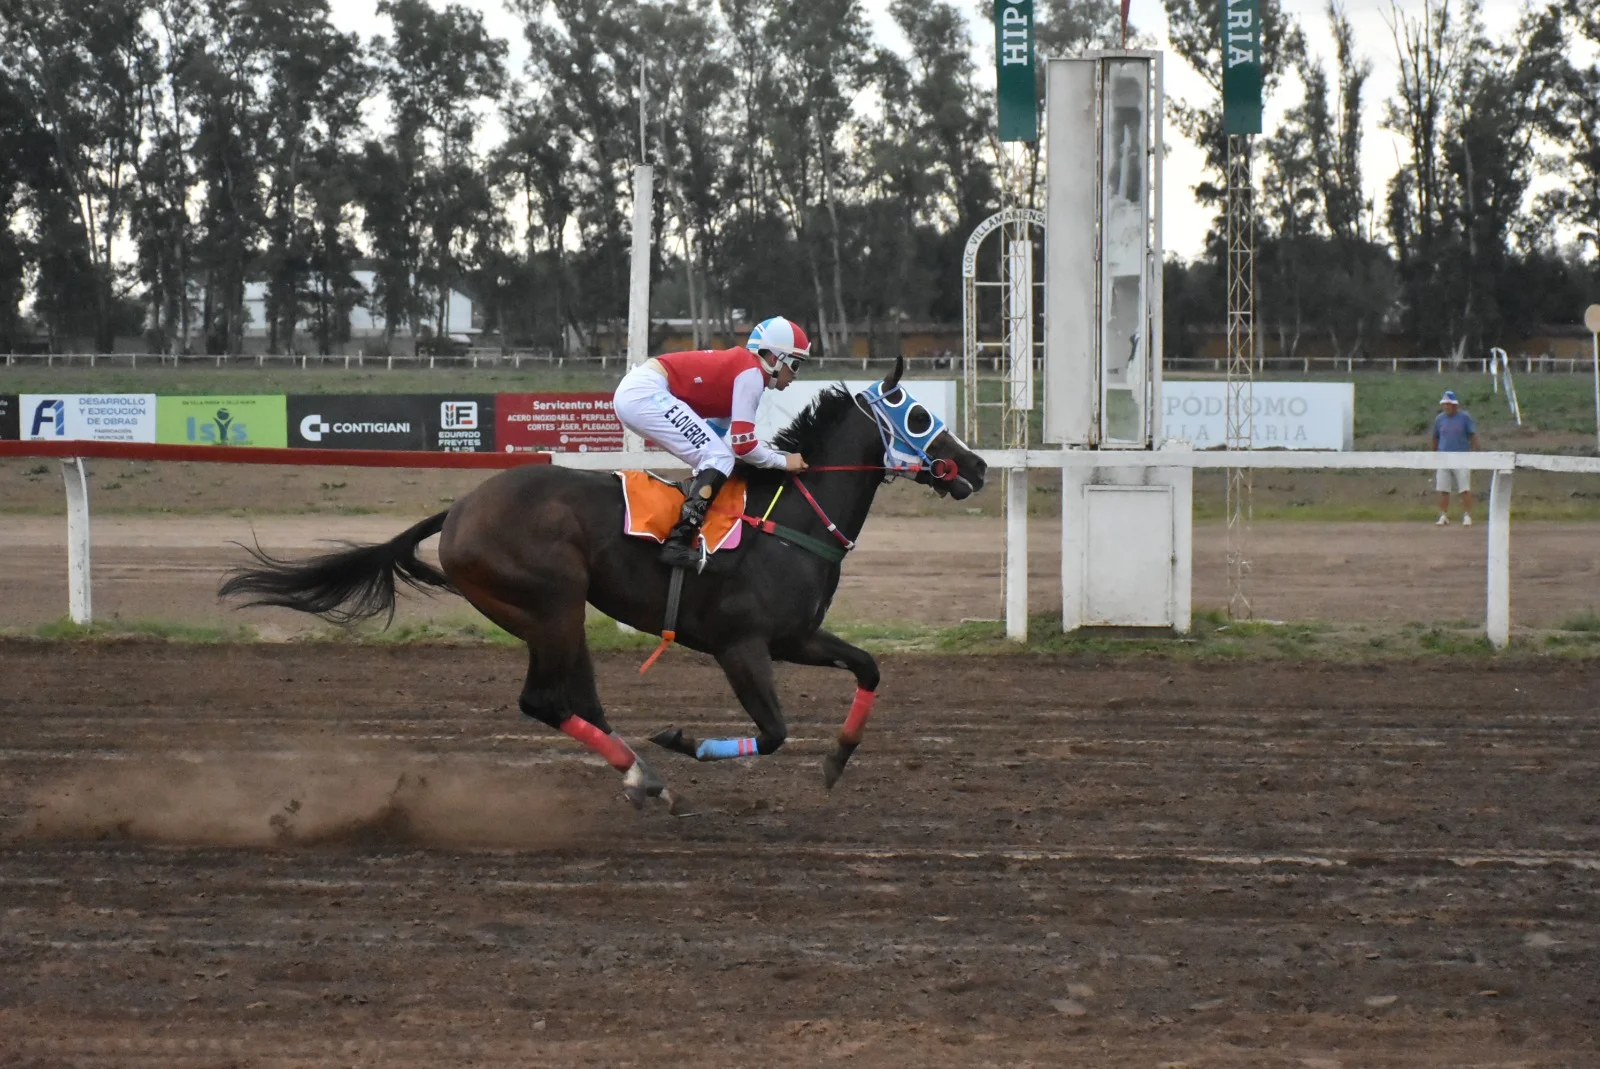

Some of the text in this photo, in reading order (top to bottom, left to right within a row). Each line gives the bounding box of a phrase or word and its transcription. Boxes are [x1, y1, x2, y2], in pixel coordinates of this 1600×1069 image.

[1003, 0, 1028, 66] HIP
[79, 397, 146, 405] DESARROLLO
[533, 400, 616, 410] Servicentro Met
[1162, 389, 1308, 417] PÓDROMO
[79, 407, 85, 415] Y
[87, 417, 138, 425] DE OBRAS
[507, 414, 531, 422] ACERO
[533, 414, 575, 422] INOXIDABLE
[581, 414, 615, 422] PERFILES
[333, 422, 411, 433] CONTIGIANI
[527, 423, 555, 431] CORTES
[583, 423, 620, 431] PLEGADOS
